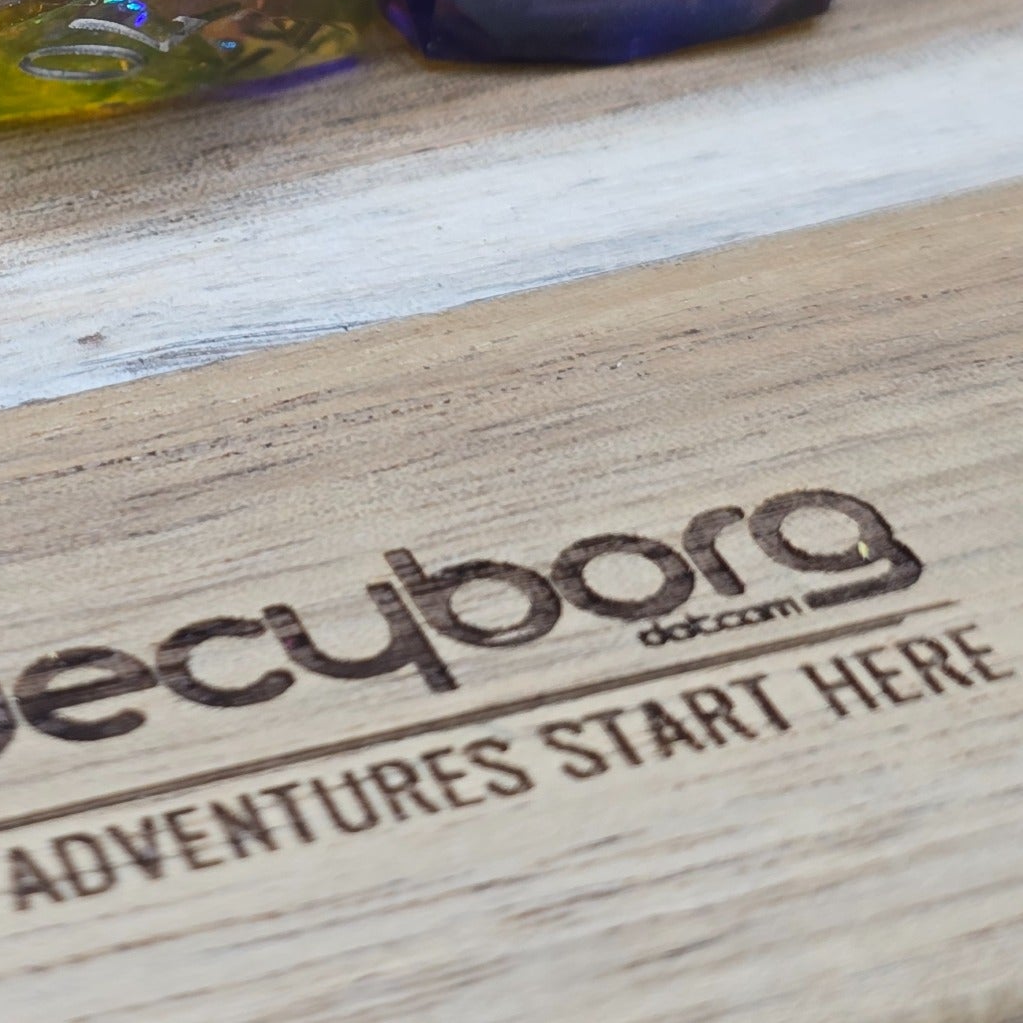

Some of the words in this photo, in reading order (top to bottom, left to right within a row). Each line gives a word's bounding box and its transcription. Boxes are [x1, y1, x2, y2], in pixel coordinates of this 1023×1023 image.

[6, 736, 535, 913] ADVENTURES
[537, 673, 794, 782] START
[799, 623, 1017, 721] HERE
